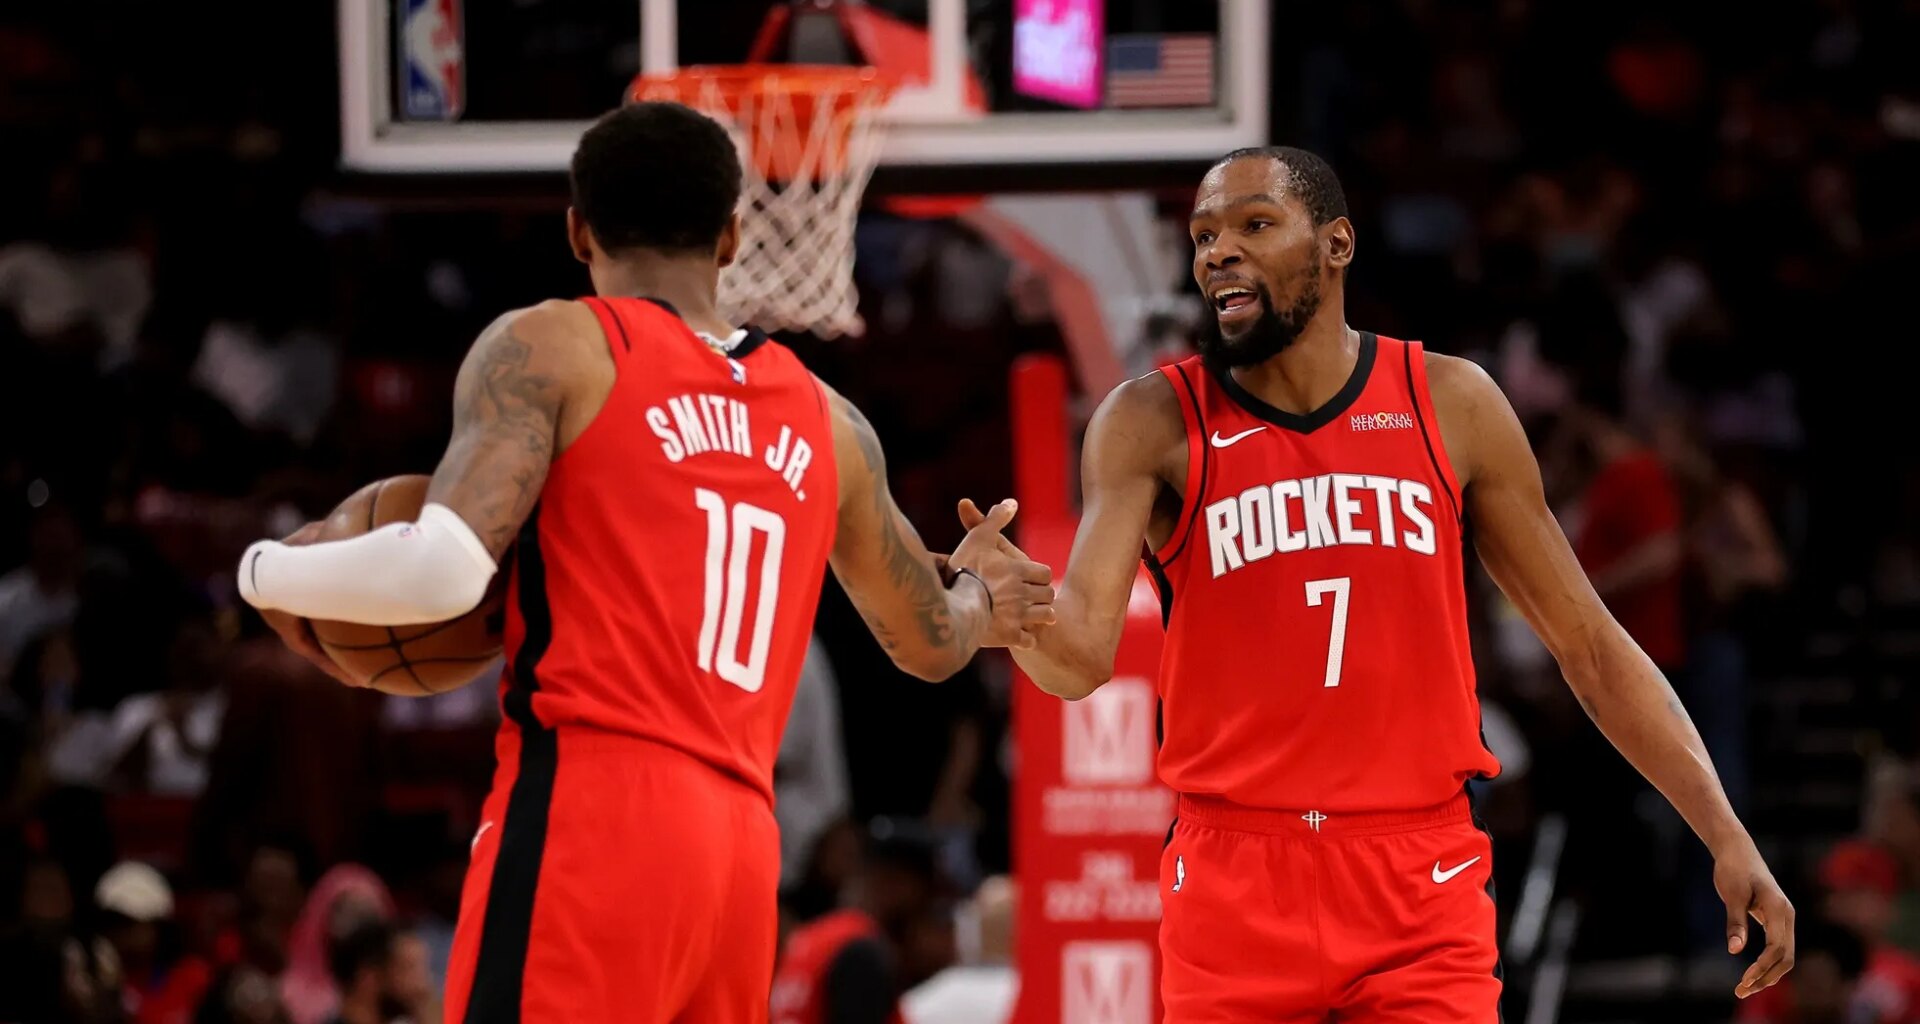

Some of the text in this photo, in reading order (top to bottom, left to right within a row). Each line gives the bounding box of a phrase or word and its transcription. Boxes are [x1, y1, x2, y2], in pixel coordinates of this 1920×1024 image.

[645, 394, 812, 501] SMITH JR.
[1350, 412, 1412, 423] MEMORIAL
[1352, 419, 1413, 431] HERMANN
[1204, 473, 1437, 579] ROCKETS
[694, 487, 786, 693] 10
[1304, 576, 1351, 688] 7
